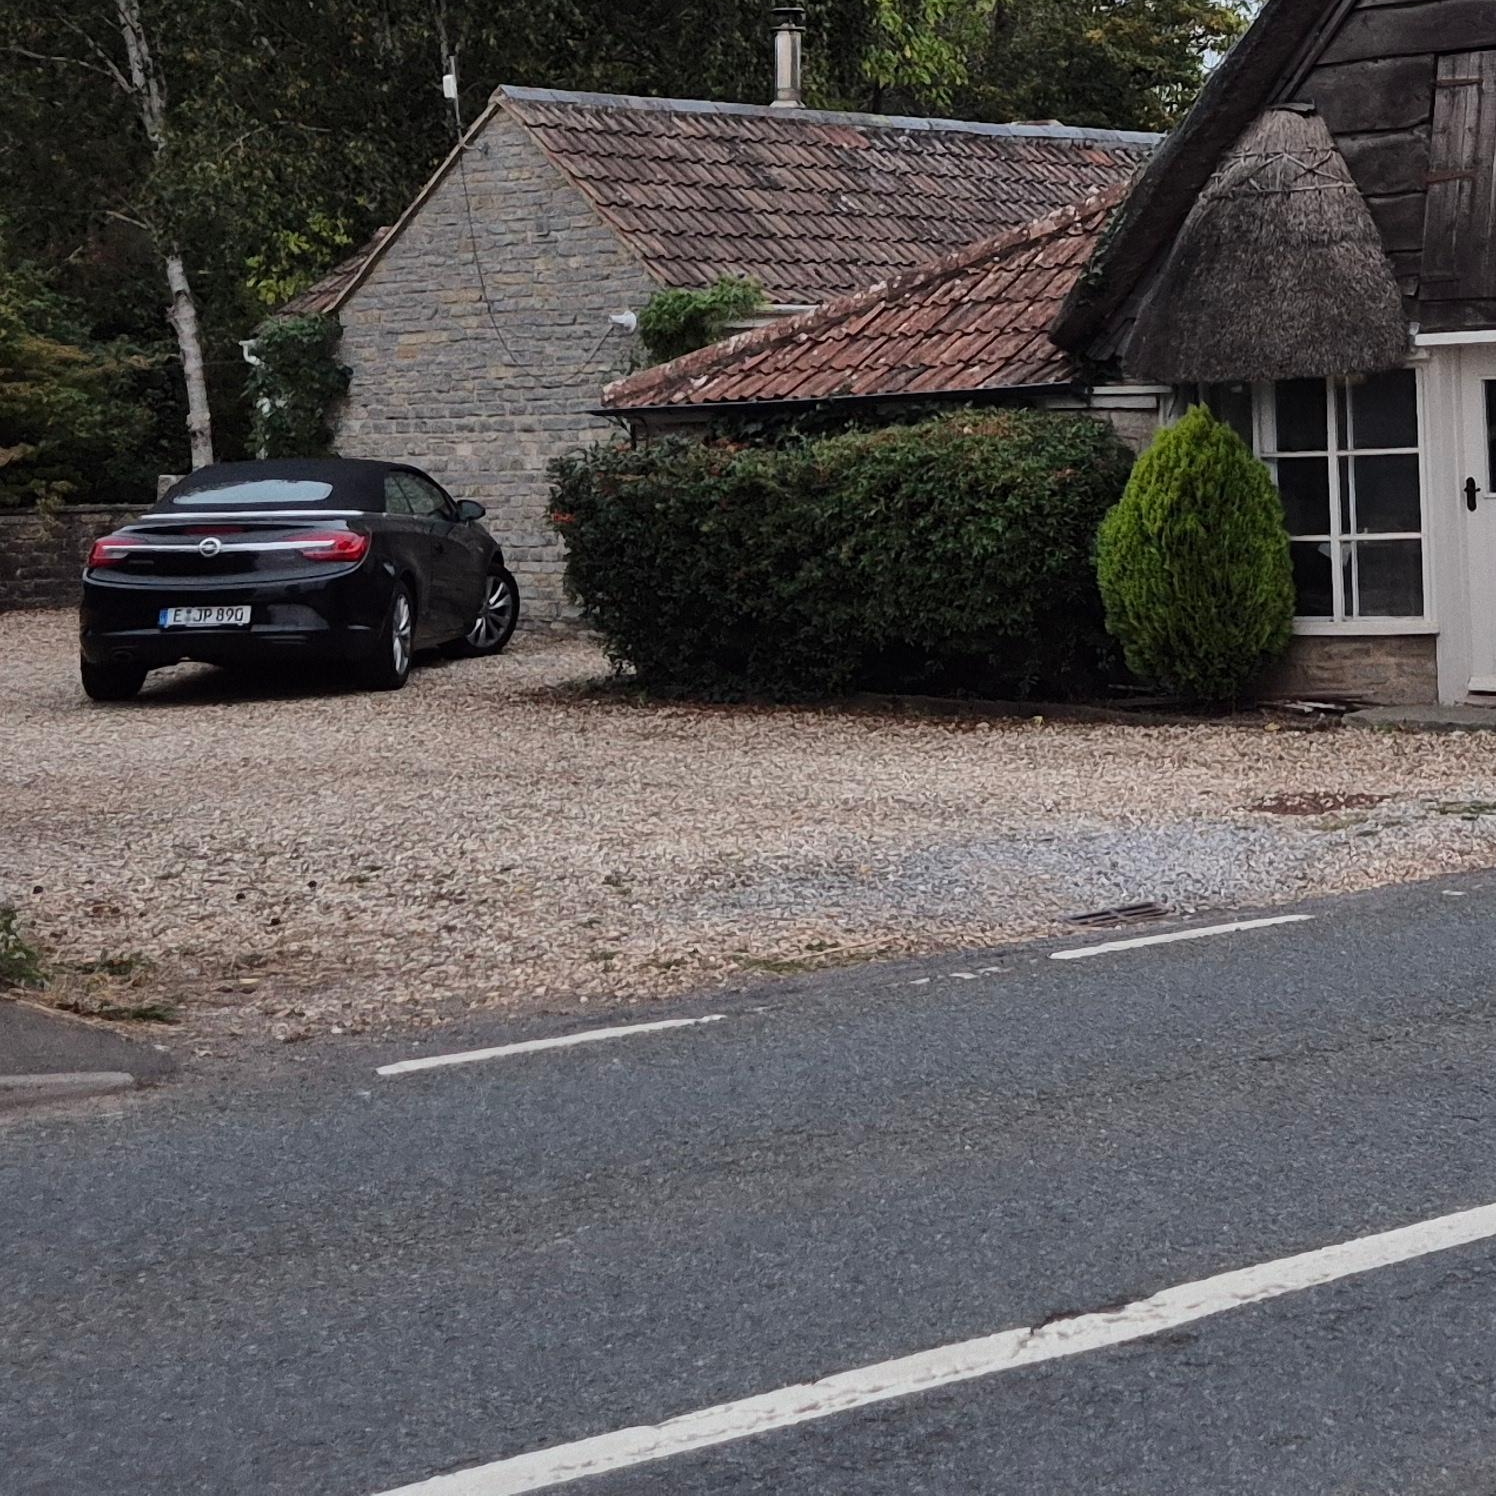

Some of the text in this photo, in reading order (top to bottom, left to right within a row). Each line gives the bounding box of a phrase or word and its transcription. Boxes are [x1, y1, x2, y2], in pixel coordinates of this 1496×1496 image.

[173, 607, 244, 622] E JP 890
